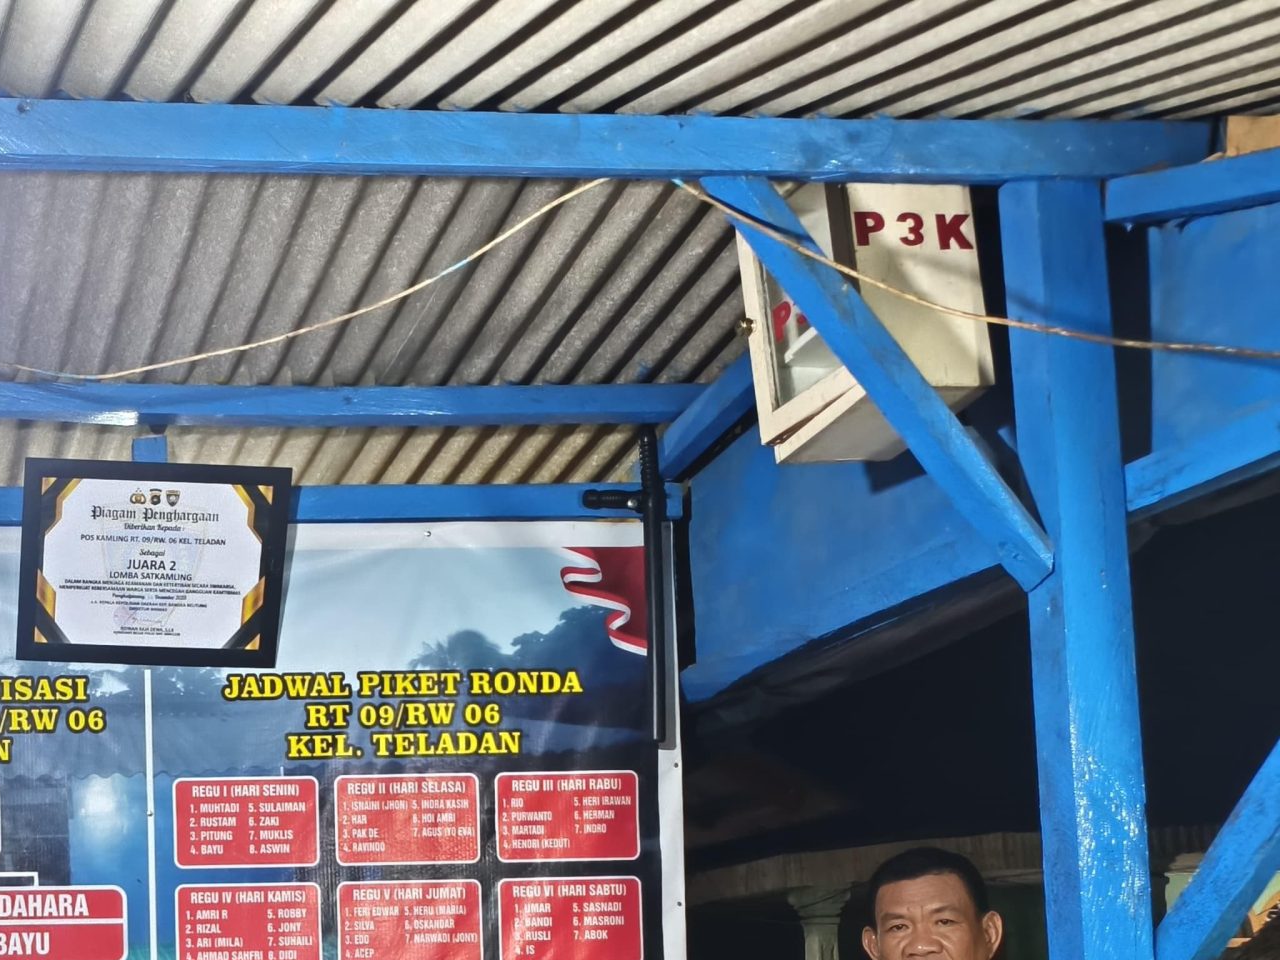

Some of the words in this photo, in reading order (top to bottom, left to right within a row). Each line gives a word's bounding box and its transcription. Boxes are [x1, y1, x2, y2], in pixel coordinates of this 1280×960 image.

[854, 211, 974, 250] P3K
[91, 505, 136, 520] Piagam
[142, 507, 220, 523] Penghargaan
[96, 534, 128, 542] KAMLING
[194, 538, 226, 546] TELADAN
[127, 559, 166, 571] JUARA
[169, 560, 176, 571] 2
[109, 571, 139, 579] LOMBA
[140, 572, 192, 581] SATKAMLING
[222, 675, 350, 698] JADWAL
[359, 673, 461, 696] PIKET
[471, 671, 583, 695] RONDA
[68, 710, 105, 732] 06
[307, 705, 351, 727] RT
[360, 704, 454, 729] 09/RW
[466, 703, 500, 725] 06
[287, 734, 363, 758] KEL.
[374, 732, 520, 756] TELADAN
[192, 786, 219, 797] REGU
[224, 786, 227, 797] I
[231, 785, 259, 797] (HARI
[263, 784, 299, 796] SENIN)
[348, 783, 374, 794] REGU
[379, 783, 385, 794] II
[390, 782, 418, 794] (HARI
[422, 781, 465, 794] SELASA)
[512, 779, 539, 791] REGU
[543, 779, 553, 791] III
[557, 779, 585, 791] (HARI
[590, 778, 621, 790] RABU)
[190, 804, 197, 813] 1.
[200, 803, 239, 813] MUHTADI
[248, 803, 256, 812] 5.
[259, 802, 305, 812] SULAIMAN
[190, 818, 198, 827] 2.
[201, 817, 236, 826] RUSTAM
[249, 817, 256, 826] 6.
[259, 817, 279, 826] ZAKI
[190, 832, 198, 840] 3.
[201, 831, 233, 840] PITUNG
[249, 831, 257, 840] 7.
[260, 830, 293, 839] MUKLIS
[201, 845, 223, 854] BAYU
[260, 844, 290, 854] ASWIN
[191, 892, 218, 904] REGU
[222, 892, 232, 903] IV
[236, 891, 264, 904] (HARI
[268, 890, 305, 903] KAMIS)
[353, 889, 380, 900] REGU
[384, 889, 390, 900] V
[394, 888, 422, 900] (HARI
[426, 887, 465, 899] JUMAT)
[513, 885, 540, 897] REGU
[544, 885, 553, 896] VI
[558, 885, 586, 897] (HARI
[589, 884, 626, 896] SABTU)
